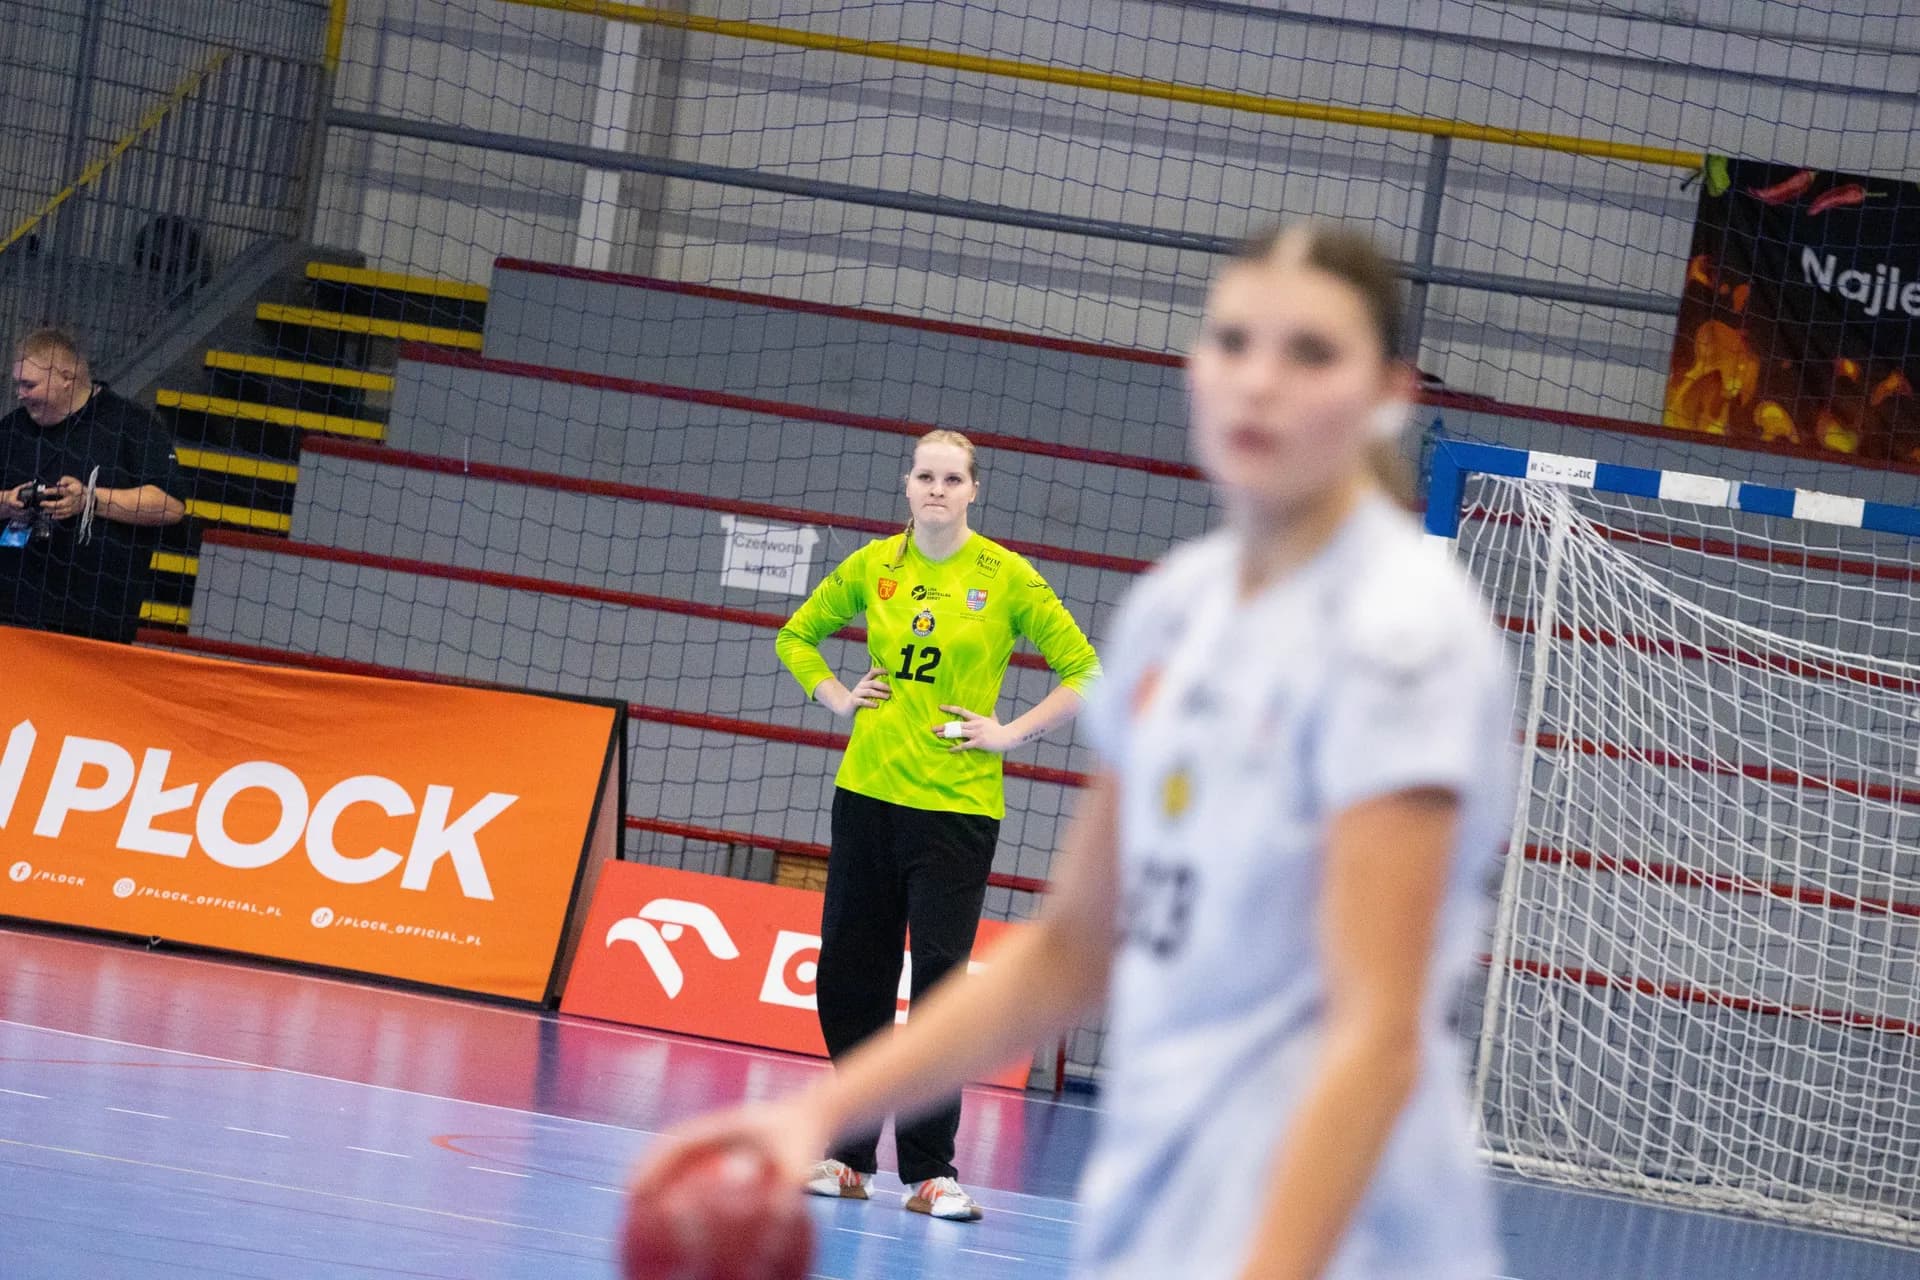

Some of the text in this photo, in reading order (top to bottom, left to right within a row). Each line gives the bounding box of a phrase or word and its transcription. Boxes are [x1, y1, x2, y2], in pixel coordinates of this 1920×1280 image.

[1800, 245, 1920, 317] Najle
[895, 643, 942, 684] 12
[33, 735, 520, 902] PŁOCK
[33, 870, 86, 887] /PLOCK
[137, 886, 283, 917] /PLOCK_OFFICIAL_PL
[335, 915, 483, 947] /PLOCK_OFFICIAL_PL
